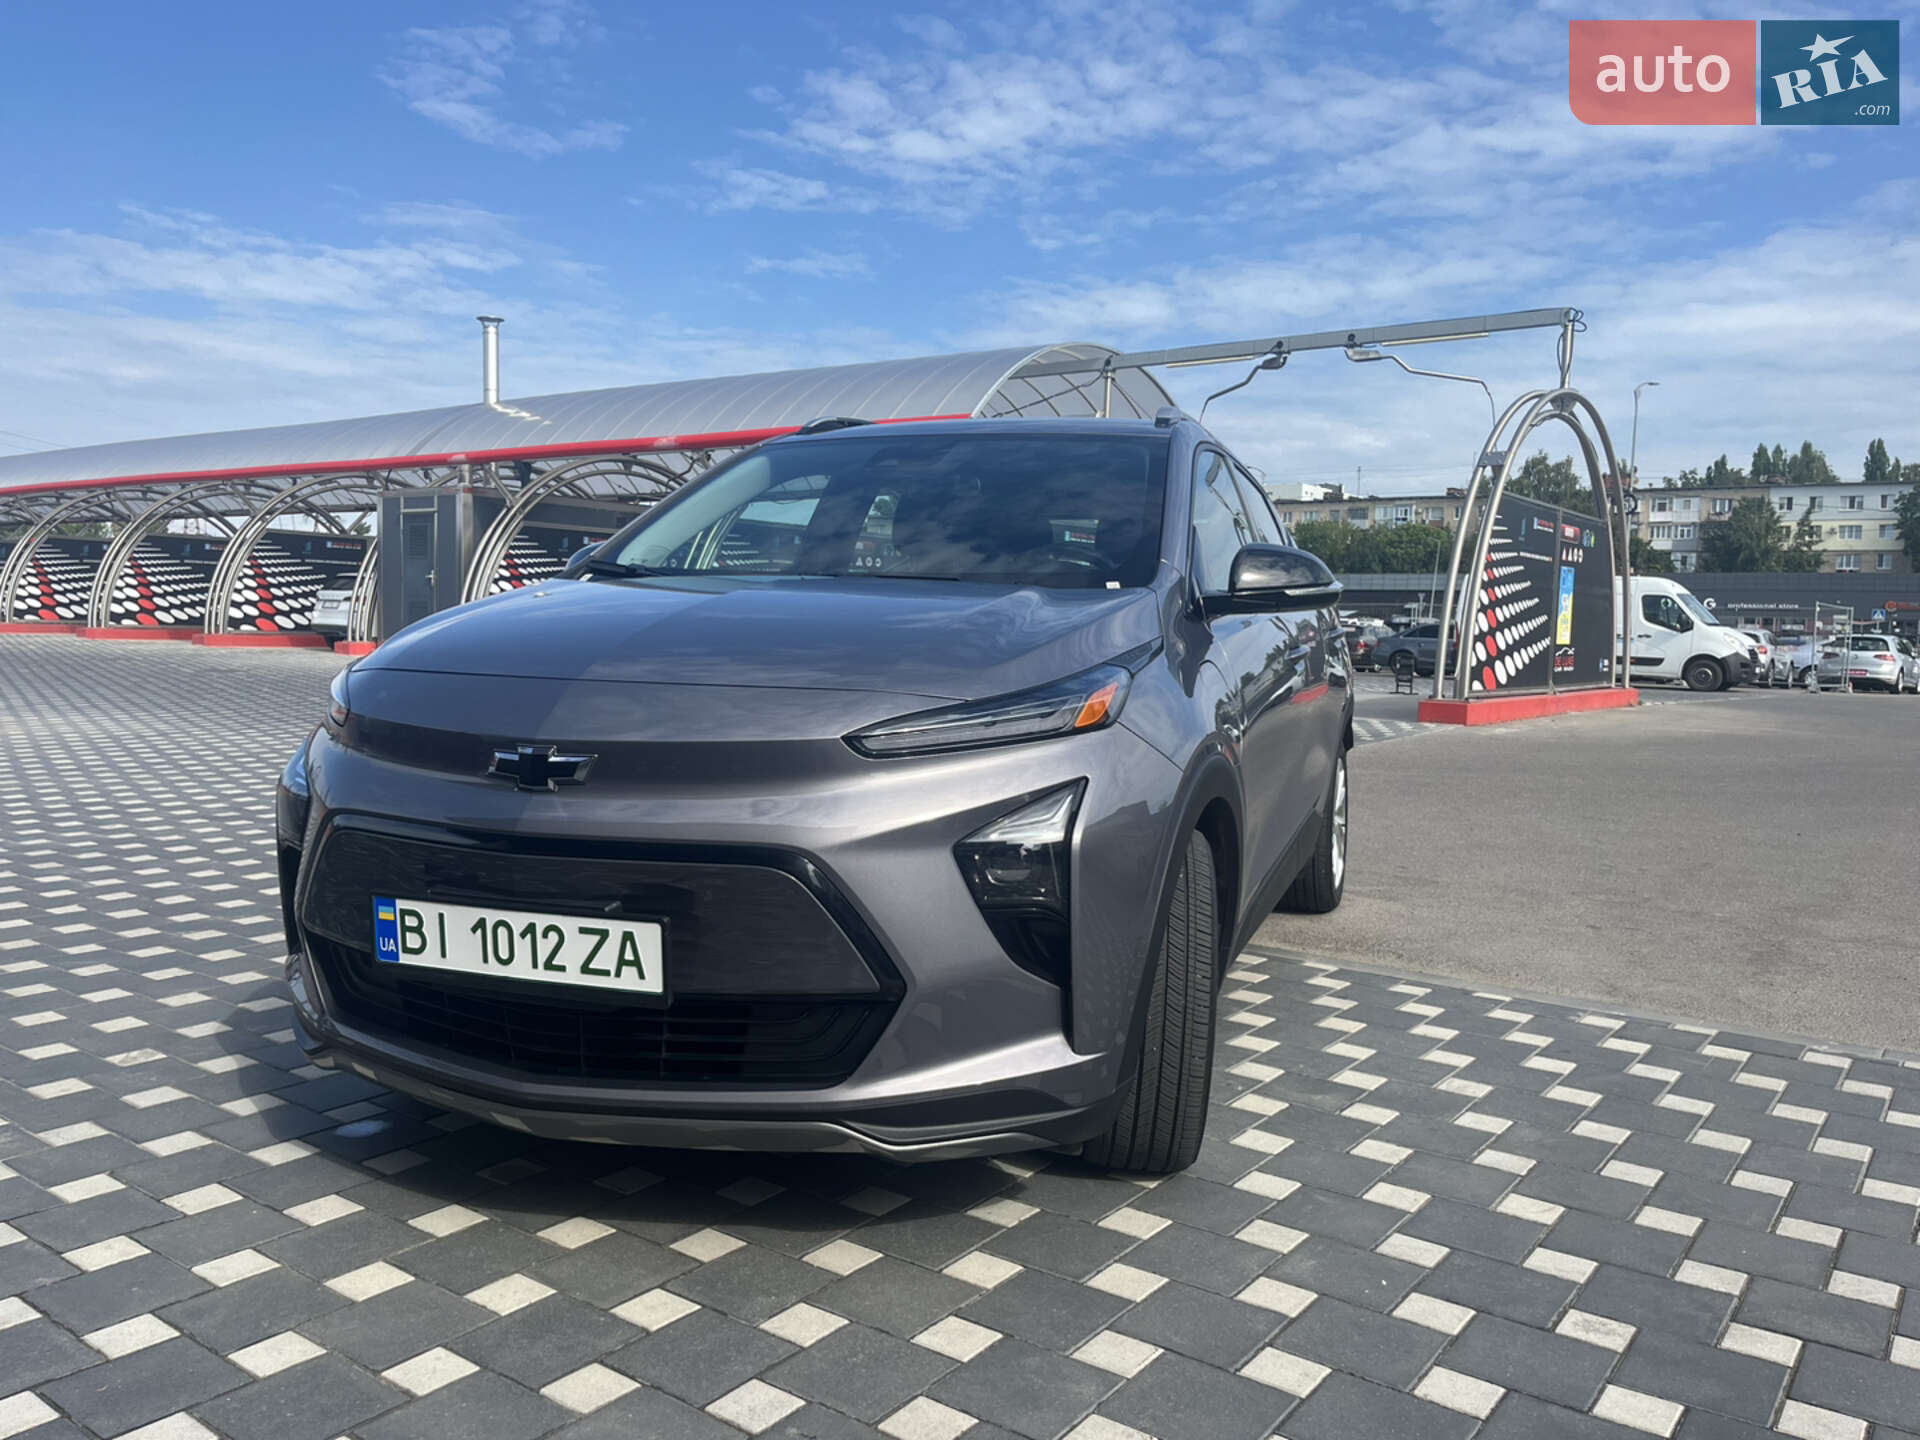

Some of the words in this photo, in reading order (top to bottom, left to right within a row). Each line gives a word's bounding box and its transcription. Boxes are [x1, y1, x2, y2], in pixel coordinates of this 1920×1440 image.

[1728, 602, 1776, 611] professional
[379, 937, 397, 953] UA
[399, 908, 447, 959] BI
[470, 917, 567, 973] 1012
[578, 926, 646, 980] ZA
